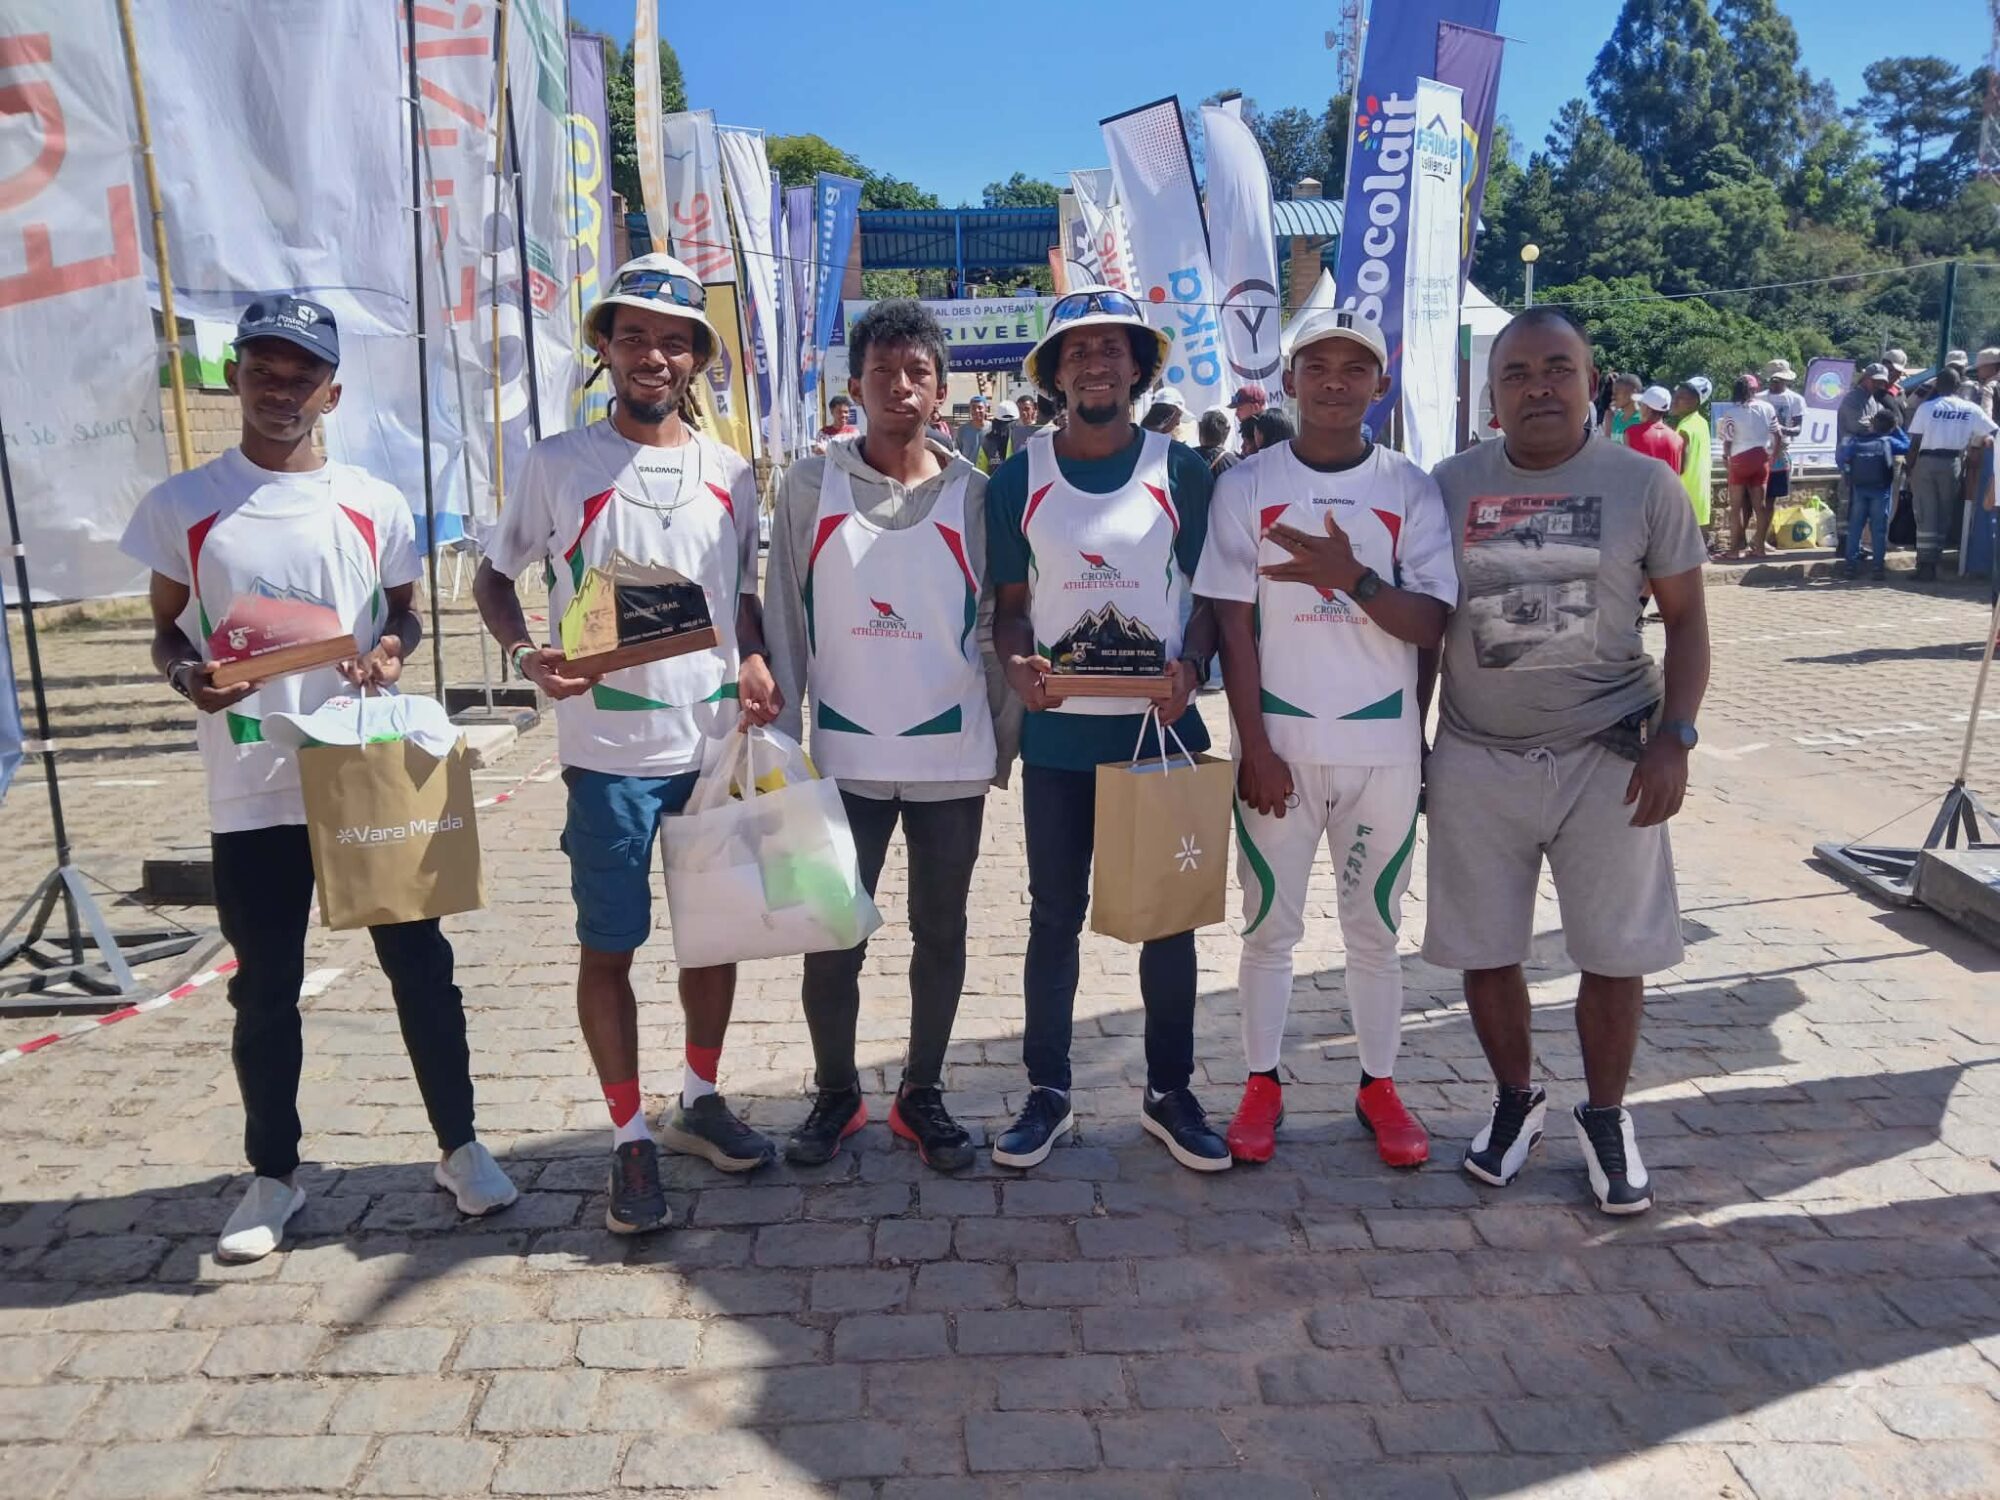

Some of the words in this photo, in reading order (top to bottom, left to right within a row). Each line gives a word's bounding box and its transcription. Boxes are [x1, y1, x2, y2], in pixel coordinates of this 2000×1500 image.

[952, 306, 971, 316] DES
[983, 303, 1035, 315] PLATEAUX
[942, 324, 1029, 341] RIVEE
[638, 465, 683, 475] SALOMON
[1312, 497, 1356, 506] SALOMON
[1081, 571, 1121, 581] CROWN
[1062, 581, 1114, 590] ATHLETICS
[1115, 580, 1140, 589] CLUB
[1313, 605, 1351, 615] CROWN
[869, 619, 907, 631] CROWN
[1294, 614, 1345, 624] ATHLETICS
[1345, 615, 1368, 625] CLUB
[850, 626, 900, 639] ATHLETICS
[900, 630, 923, 641] CLUB
[353, 825, 406, 842] Vara
[409, 812, 463, 837] Mada
